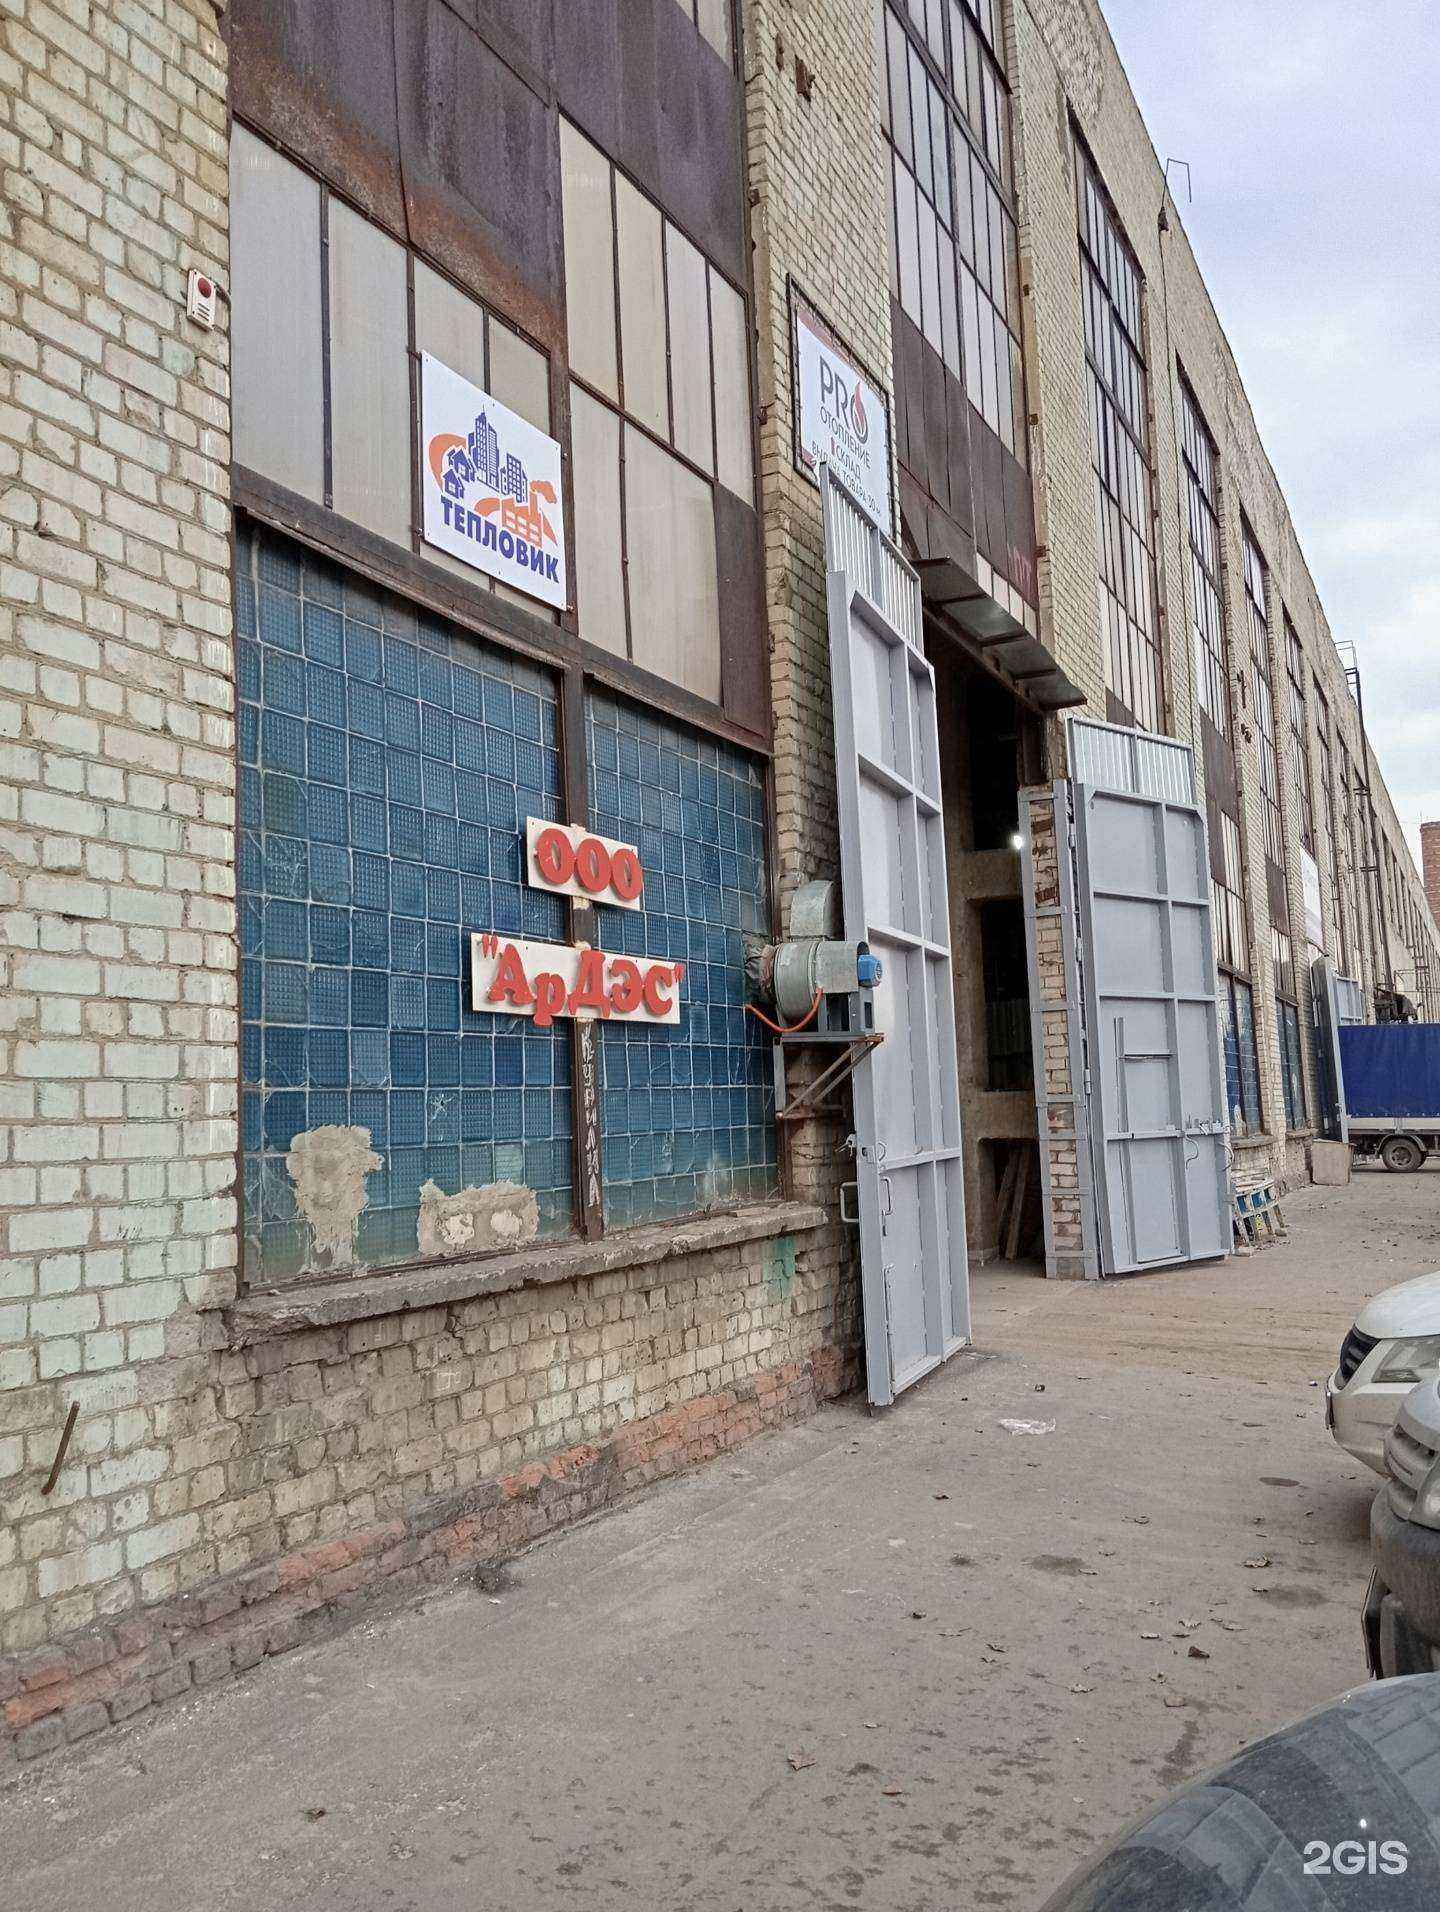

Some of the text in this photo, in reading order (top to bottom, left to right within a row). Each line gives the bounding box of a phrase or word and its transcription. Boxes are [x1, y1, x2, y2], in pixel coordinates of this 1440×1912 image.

[820, 355, 868, 444] PRO
[820, 405, 871, 470] ОТОПЛЕНИЕ
[836, 446, 861, 483] СКЛАД
[441, 494, 559, 583] ТЕПЛОВИК
[537, 828, 643, 900] ООО
